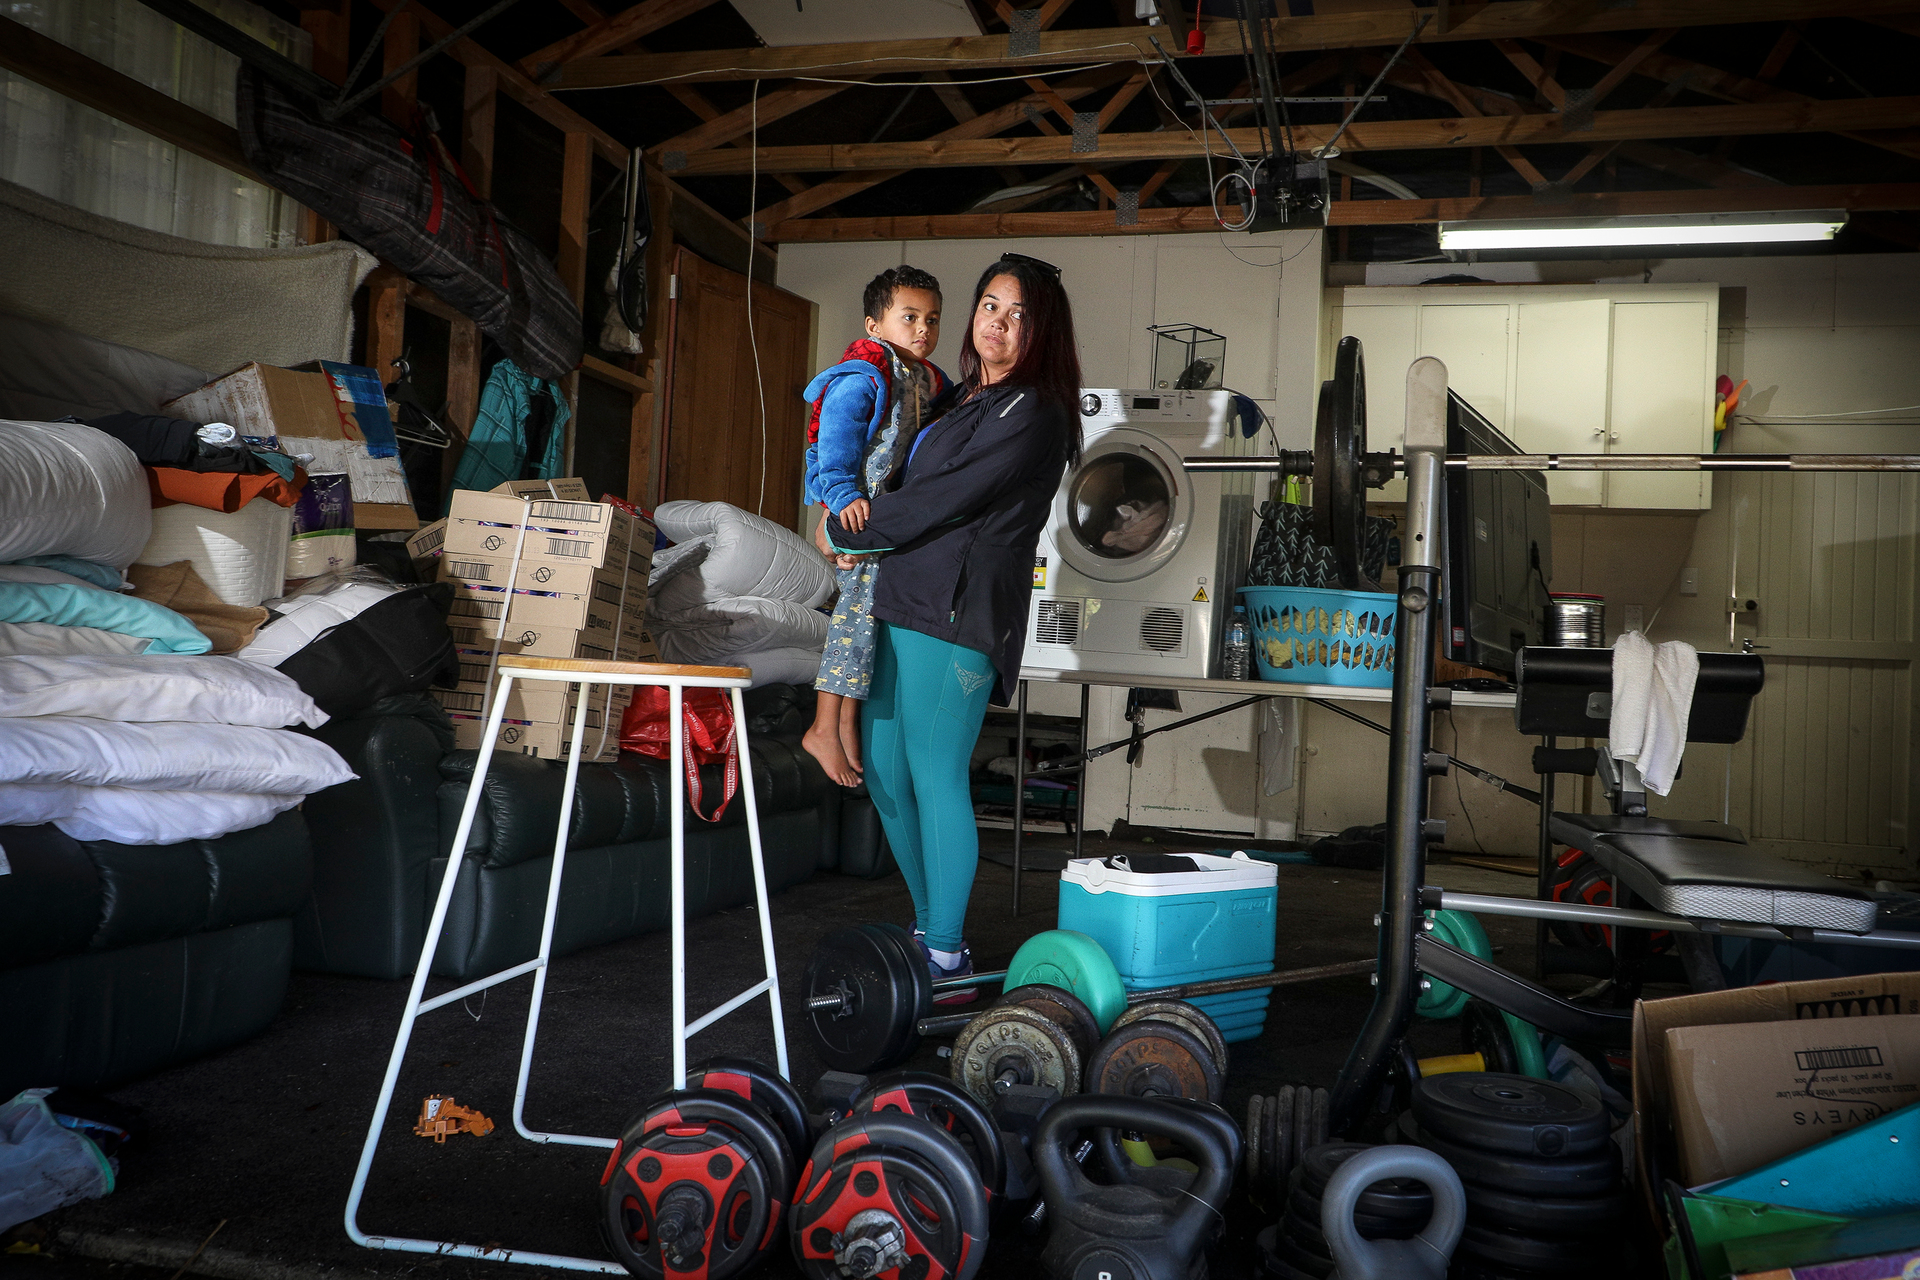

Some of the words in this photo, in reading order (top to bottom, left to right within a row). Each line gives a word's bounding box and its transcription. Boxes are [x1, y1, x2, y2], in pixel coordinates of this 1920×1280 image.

[1830, 990, 1856, 998] WIDE
[1775, 1091, 1791, 1100] Liner
[1790, 1090, 1814, 1099] Kchen
[1815, 1088, 1837, 1098] White
